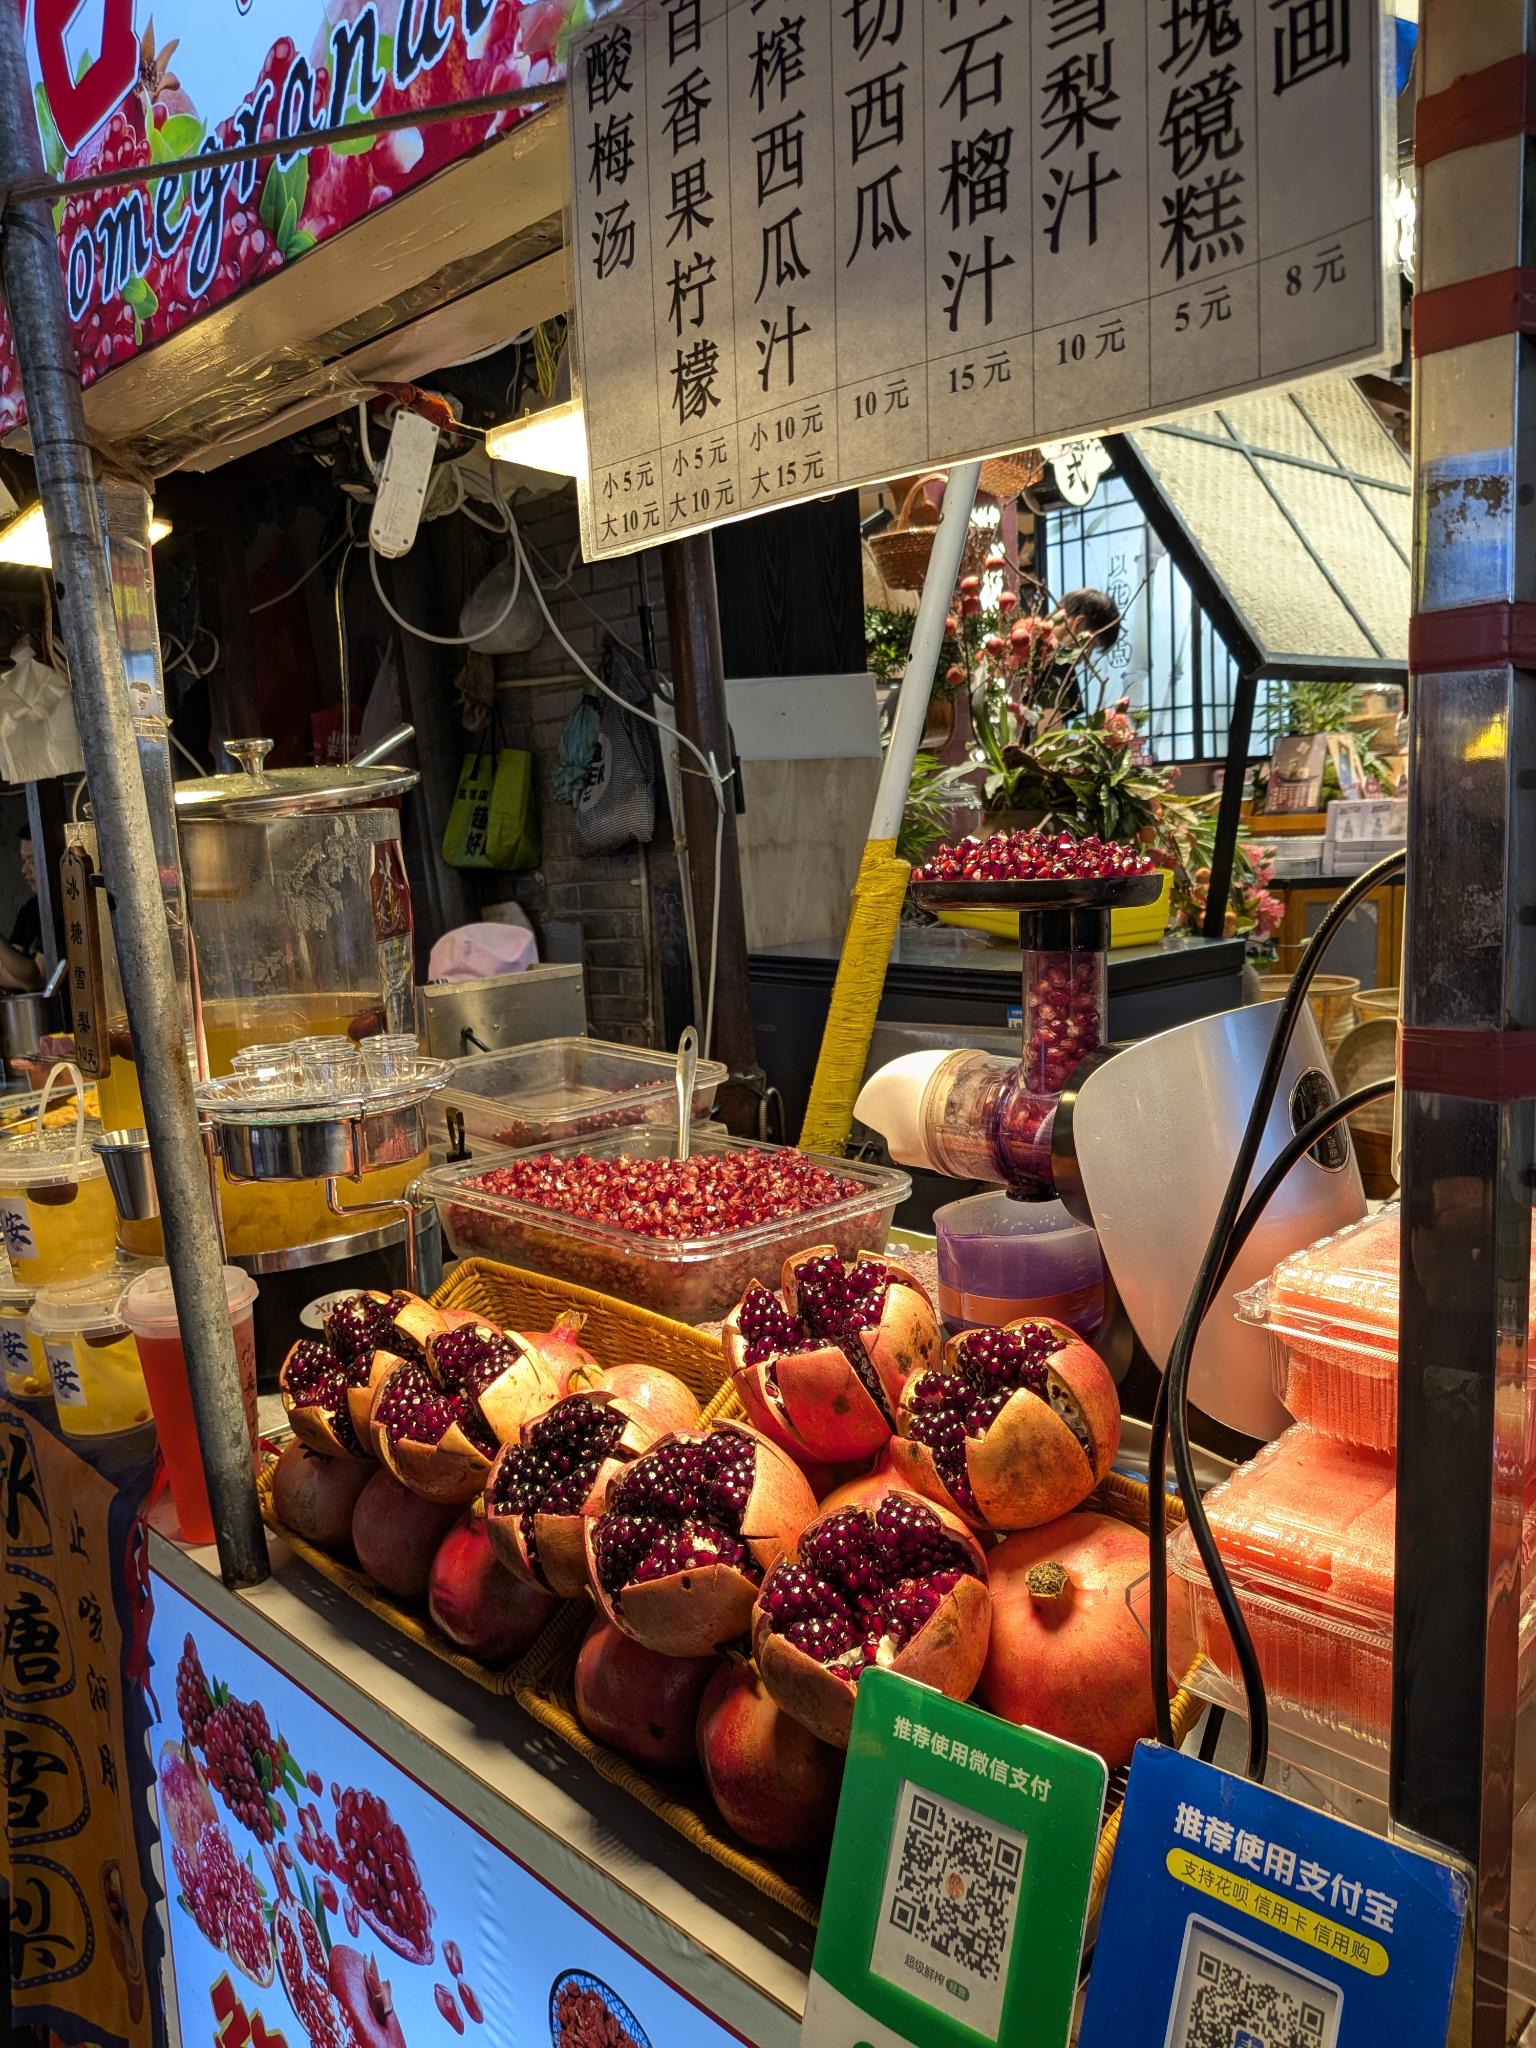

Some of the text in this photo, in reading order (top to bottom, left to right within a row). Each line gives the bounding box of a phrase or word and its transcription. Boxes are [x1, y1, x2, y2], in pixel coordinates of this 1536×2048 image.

[585, 25, 636, 281] 酸梅汤
[841, 0, 911, 268] 切西瓜
[68, 0, 497, 322] omegrana
[938, 0, 1016, 332] 石榴汁
[661, 0, 721, 426] 百香果柠檬
[749, 0, 811, 393] 榨西瓜汁
[1285, 245, 1346, 296] 8元
[1174, 286, 1232, 332] 5元
[1057, 319, 1126, 366] 10元
[948, 351, 1011, 394] 15元
[854, 378, 910, 420] 10元
[750, 403, 823, 452] 小10元
[601, 461, 655, 499] 小5元
[672, 434, 727, 478] 小5元
[750, 450, 824, 499] 大15元
[600, 501, 660, 539] 大10元
[669, 478, 735, 523] 大10元
[66, 876, 91, 1034] 冰糖雪梨
[893, 1715, 1052, 1803] 推荐使用微信支付
[1173, 1802, 1399, 1934] 推荐使用支付宝
[1181, 1859, 1371, 1965] 支持花呗 信用卡 信用购
